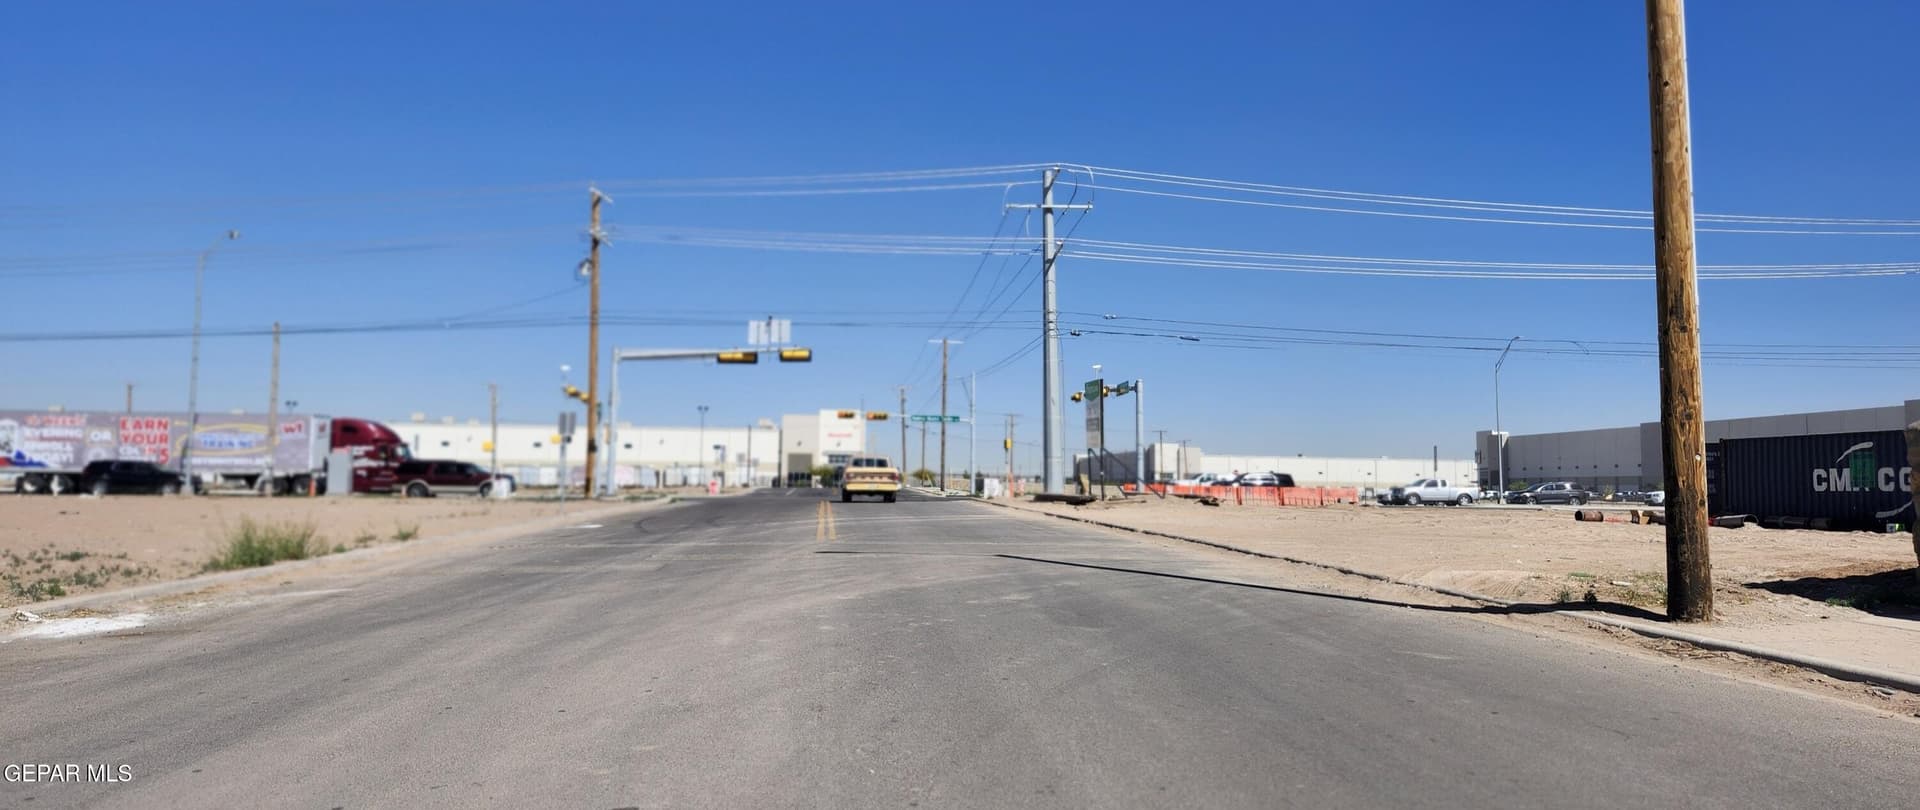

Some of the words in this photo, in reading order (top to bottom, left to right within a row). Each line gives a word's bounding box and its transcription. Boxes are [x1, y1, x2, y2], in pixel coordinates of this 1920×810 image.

[119, 416, 169, 430] EARN
[120, 431, 169, 445] YOUR
[1812, 467, 1870, 492] CM
